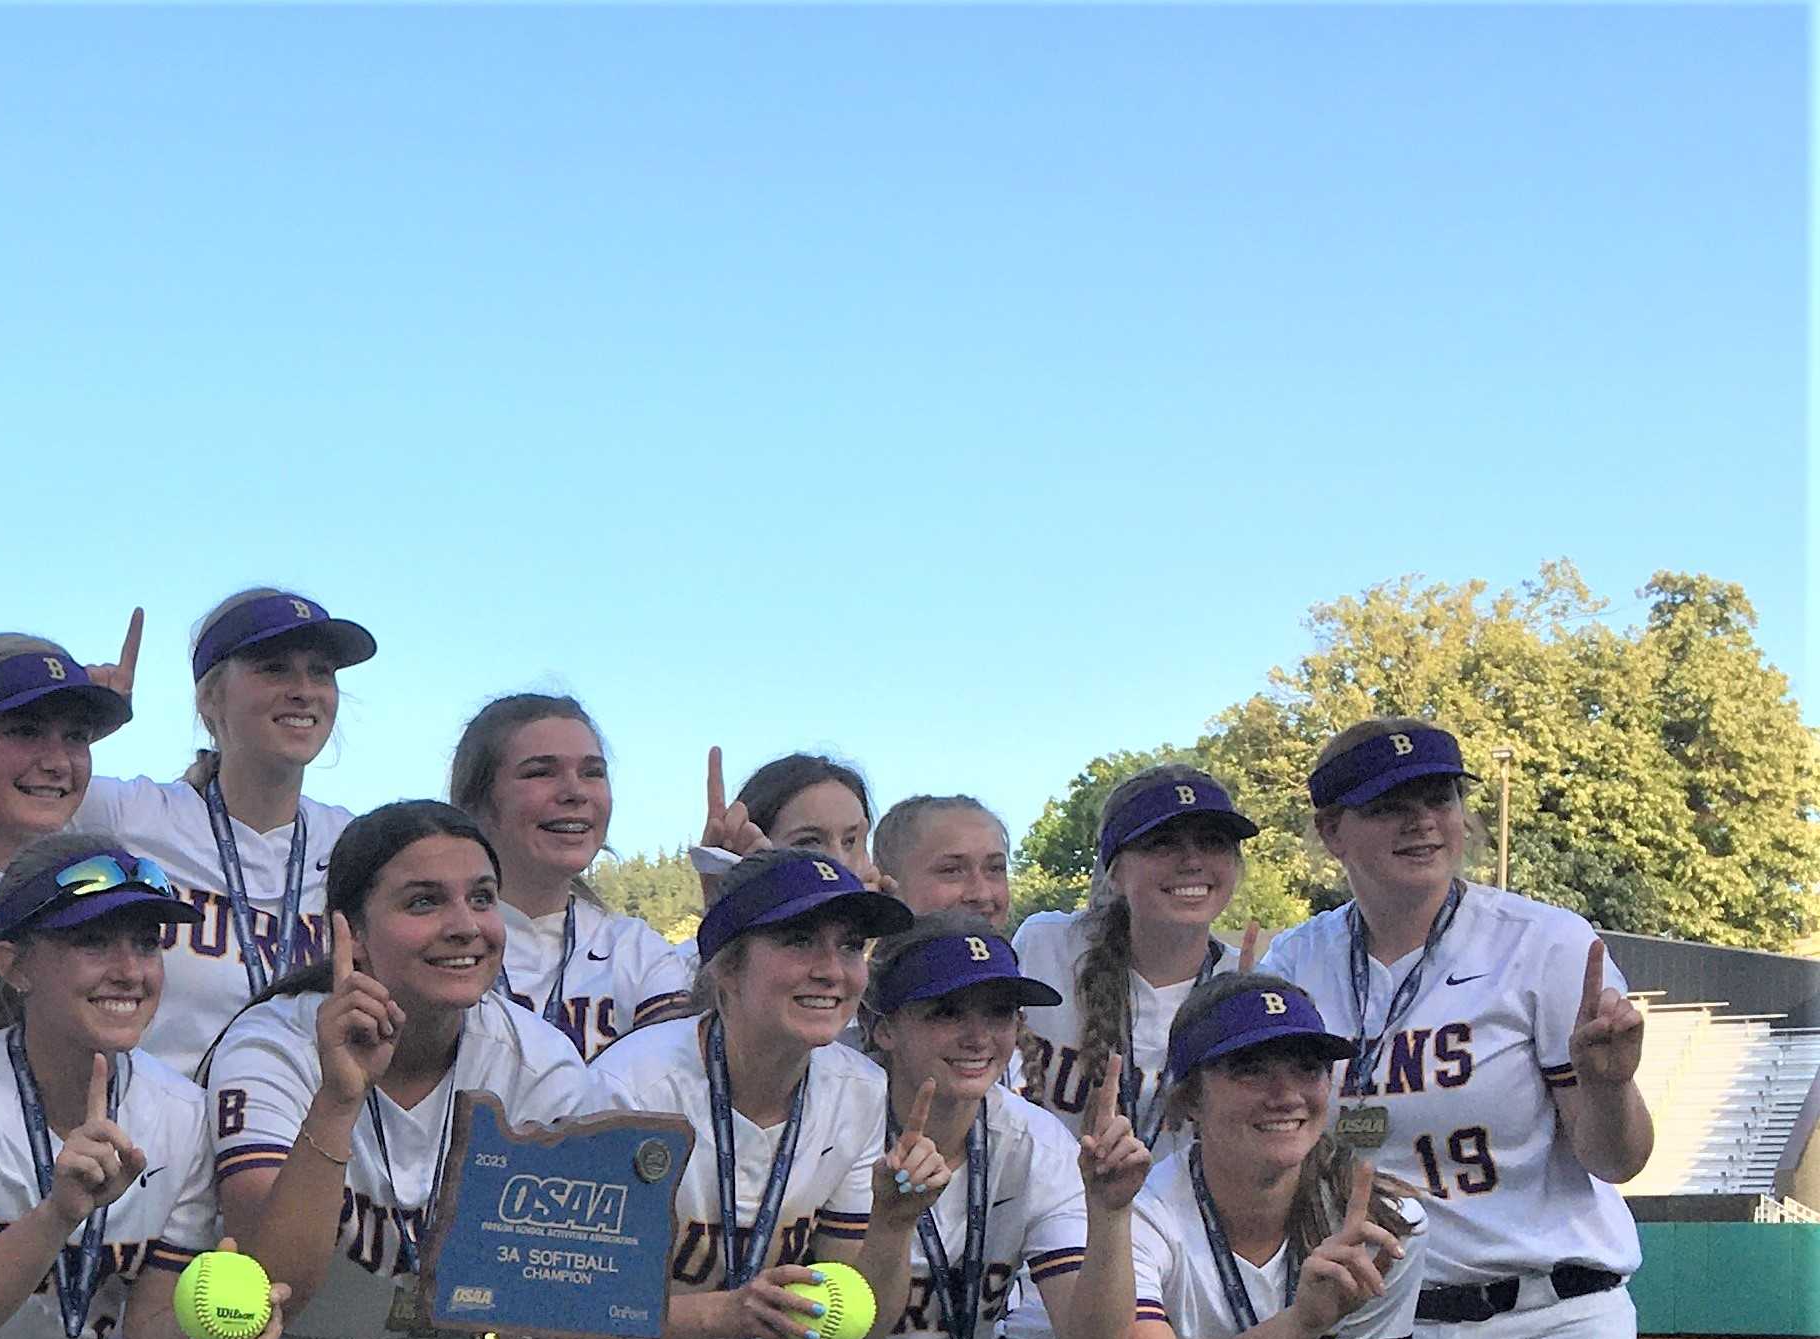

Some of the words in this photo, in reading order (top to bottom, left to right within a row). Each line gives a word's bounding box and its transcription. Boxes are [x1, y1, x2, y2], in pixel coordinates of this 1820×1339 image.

[290, 599, 311, 619] B
[43, 657, 66, 680] B
[1388, 732, 1413, 756] B
[1175, 785, 1196, 807] B
[813, 861, 842, 882] B
[965, 937, 991, 961] B
[1261, 992, 1287, 1015] B
[217, 1089, 247, 1138] B
[475, 1153, 507, 1168] 2023
[1415, 1125, 1499, 1200] 19
[499, 1174, 628, 1234] OSAA
[497, 1246, 520, 1262] 3A
[528, 1249, 619, 1272] SOFTBALL
[522, 1266, 592, 1284] CHAMPION
[216, 1307, 255, 1320] Wilson
[609, 1305, 648, 1321] OnPoint
